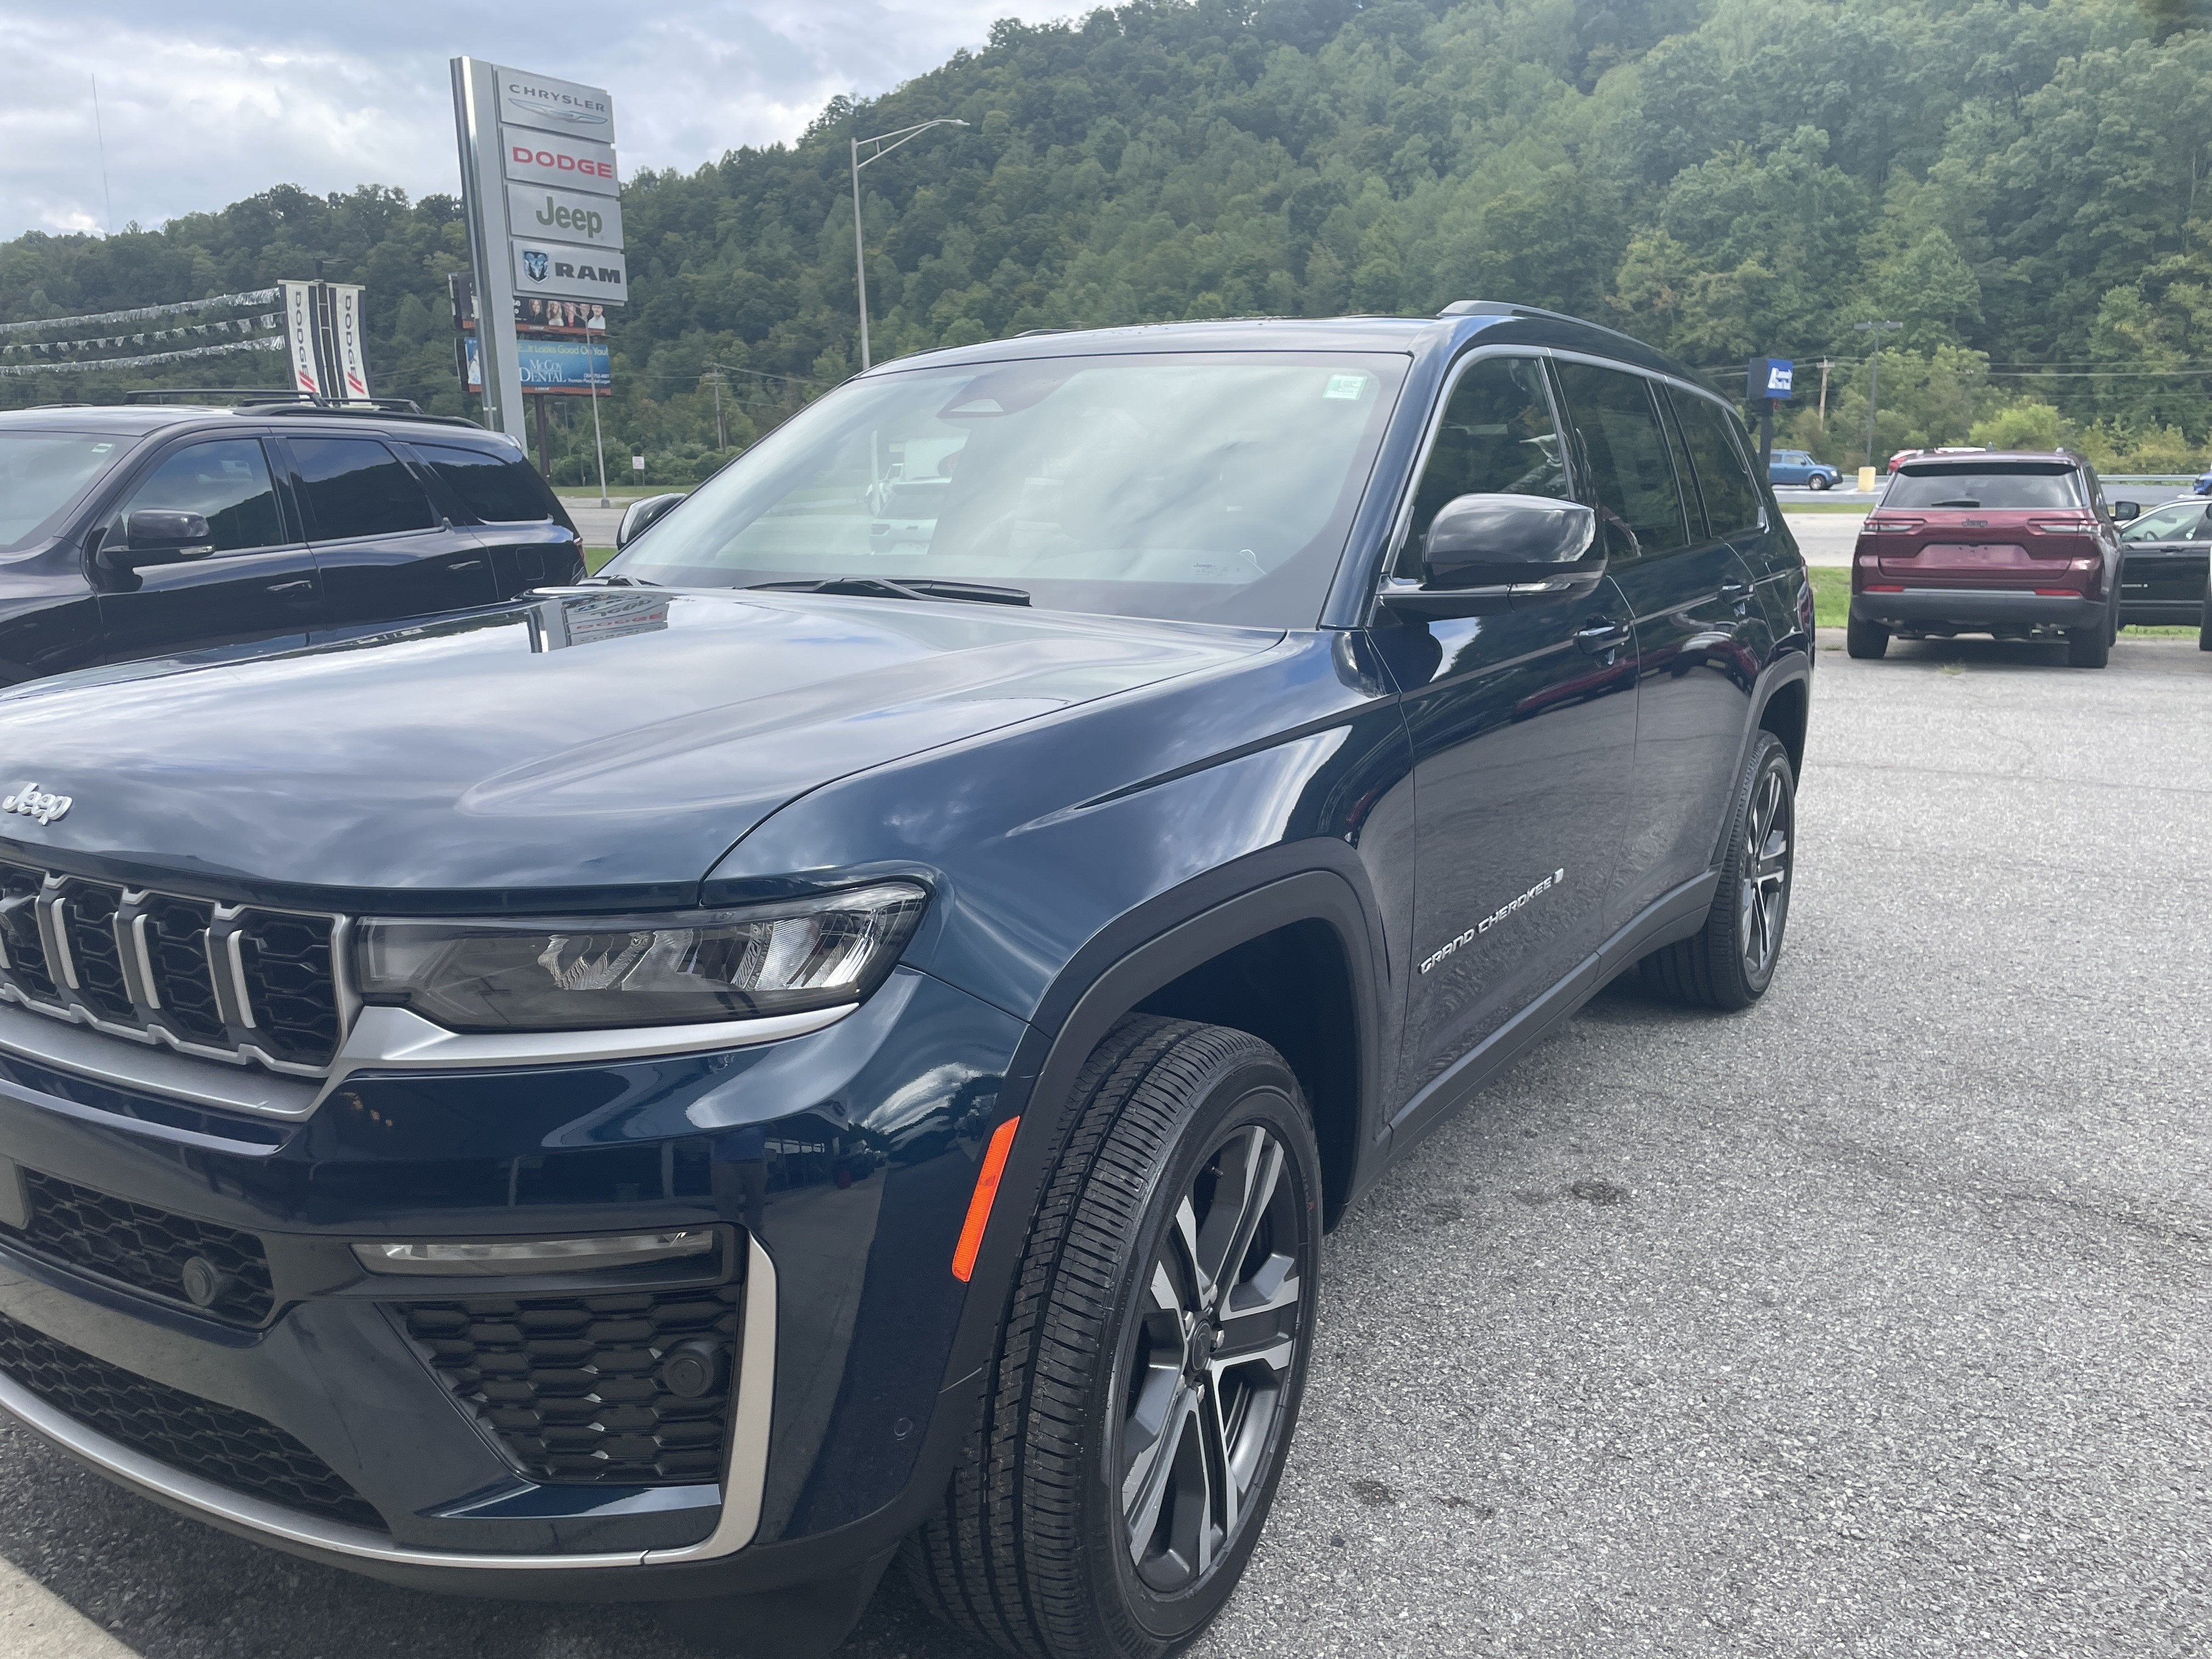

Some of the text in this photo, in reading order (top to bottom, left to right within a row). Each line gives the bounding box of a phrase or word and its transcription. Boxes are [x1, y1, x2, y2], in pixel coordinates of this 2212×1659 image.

[509, 84, 605, 112] CHRYSLER
[512, 146, 612, 179] DODGE
[535, 196, 602, 238] Jeep
[555, 262, 621, 284] RAM
[296, 291, 309, 377] DODGE
[345, 295, 357, 378] DODGE
[535, 345, 556, 354] Looks
[558, 345, 579, 354] Good
[2, 782, 72, 826] Jeep
[1420, 876, 1552, 975] GRAND CHEROKEE
